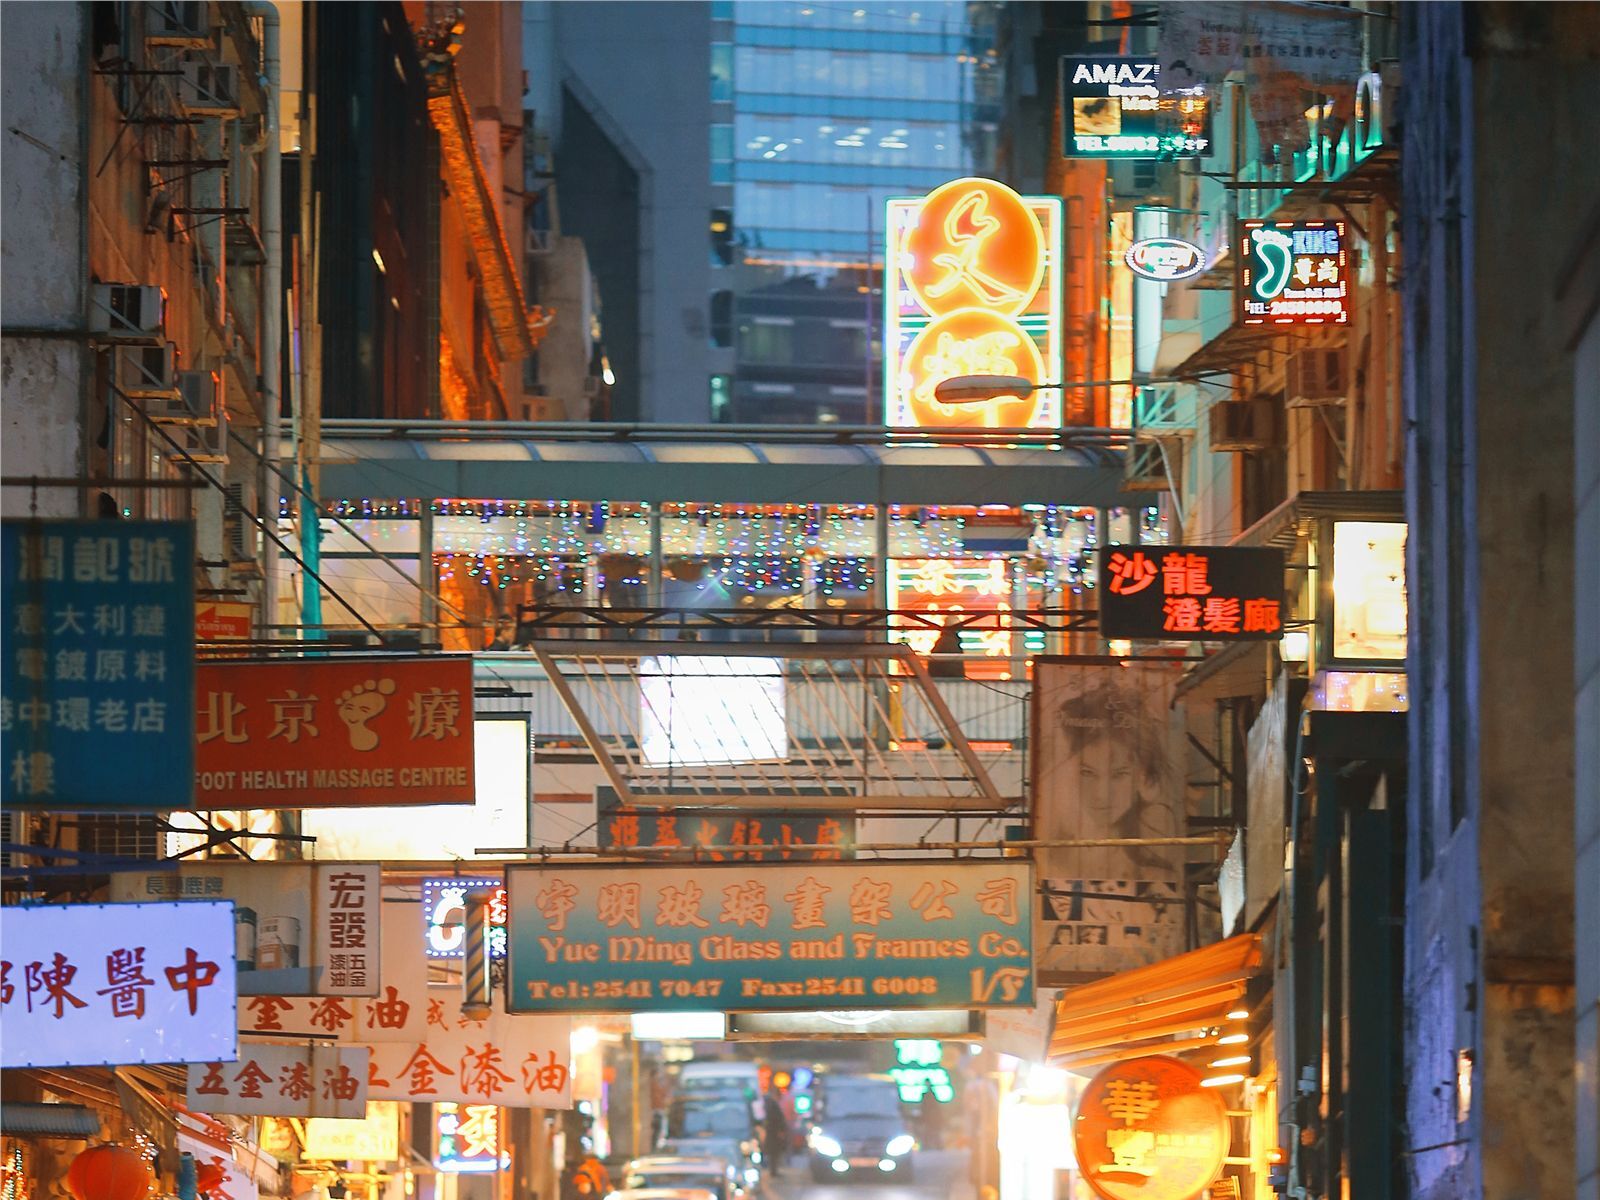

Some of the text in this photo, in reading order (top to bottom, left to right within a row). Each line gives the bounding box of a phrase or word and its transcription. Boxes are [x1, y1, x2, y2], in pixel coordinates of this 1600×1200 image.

[1293, 230, 1339, 254] KING
[1107, 551, 1213, 596] 沙龍
[1162, 597, 1281, 634] 澄髮廊
[241, 770, 308, 790] HEALTH
[313, 768, 394, 788] MASSAGE
[399, 766, 467, 788] CENTRE
[329, 872, 366, 949] 宏發
[538, 931, 1029, 965] Yue Ming Glass and Frames Co.
[659, 979, 723, 998] 7047
[872, 976, 938, 995] 6008
[195, 1060, 361, 1101] 五金漆油
